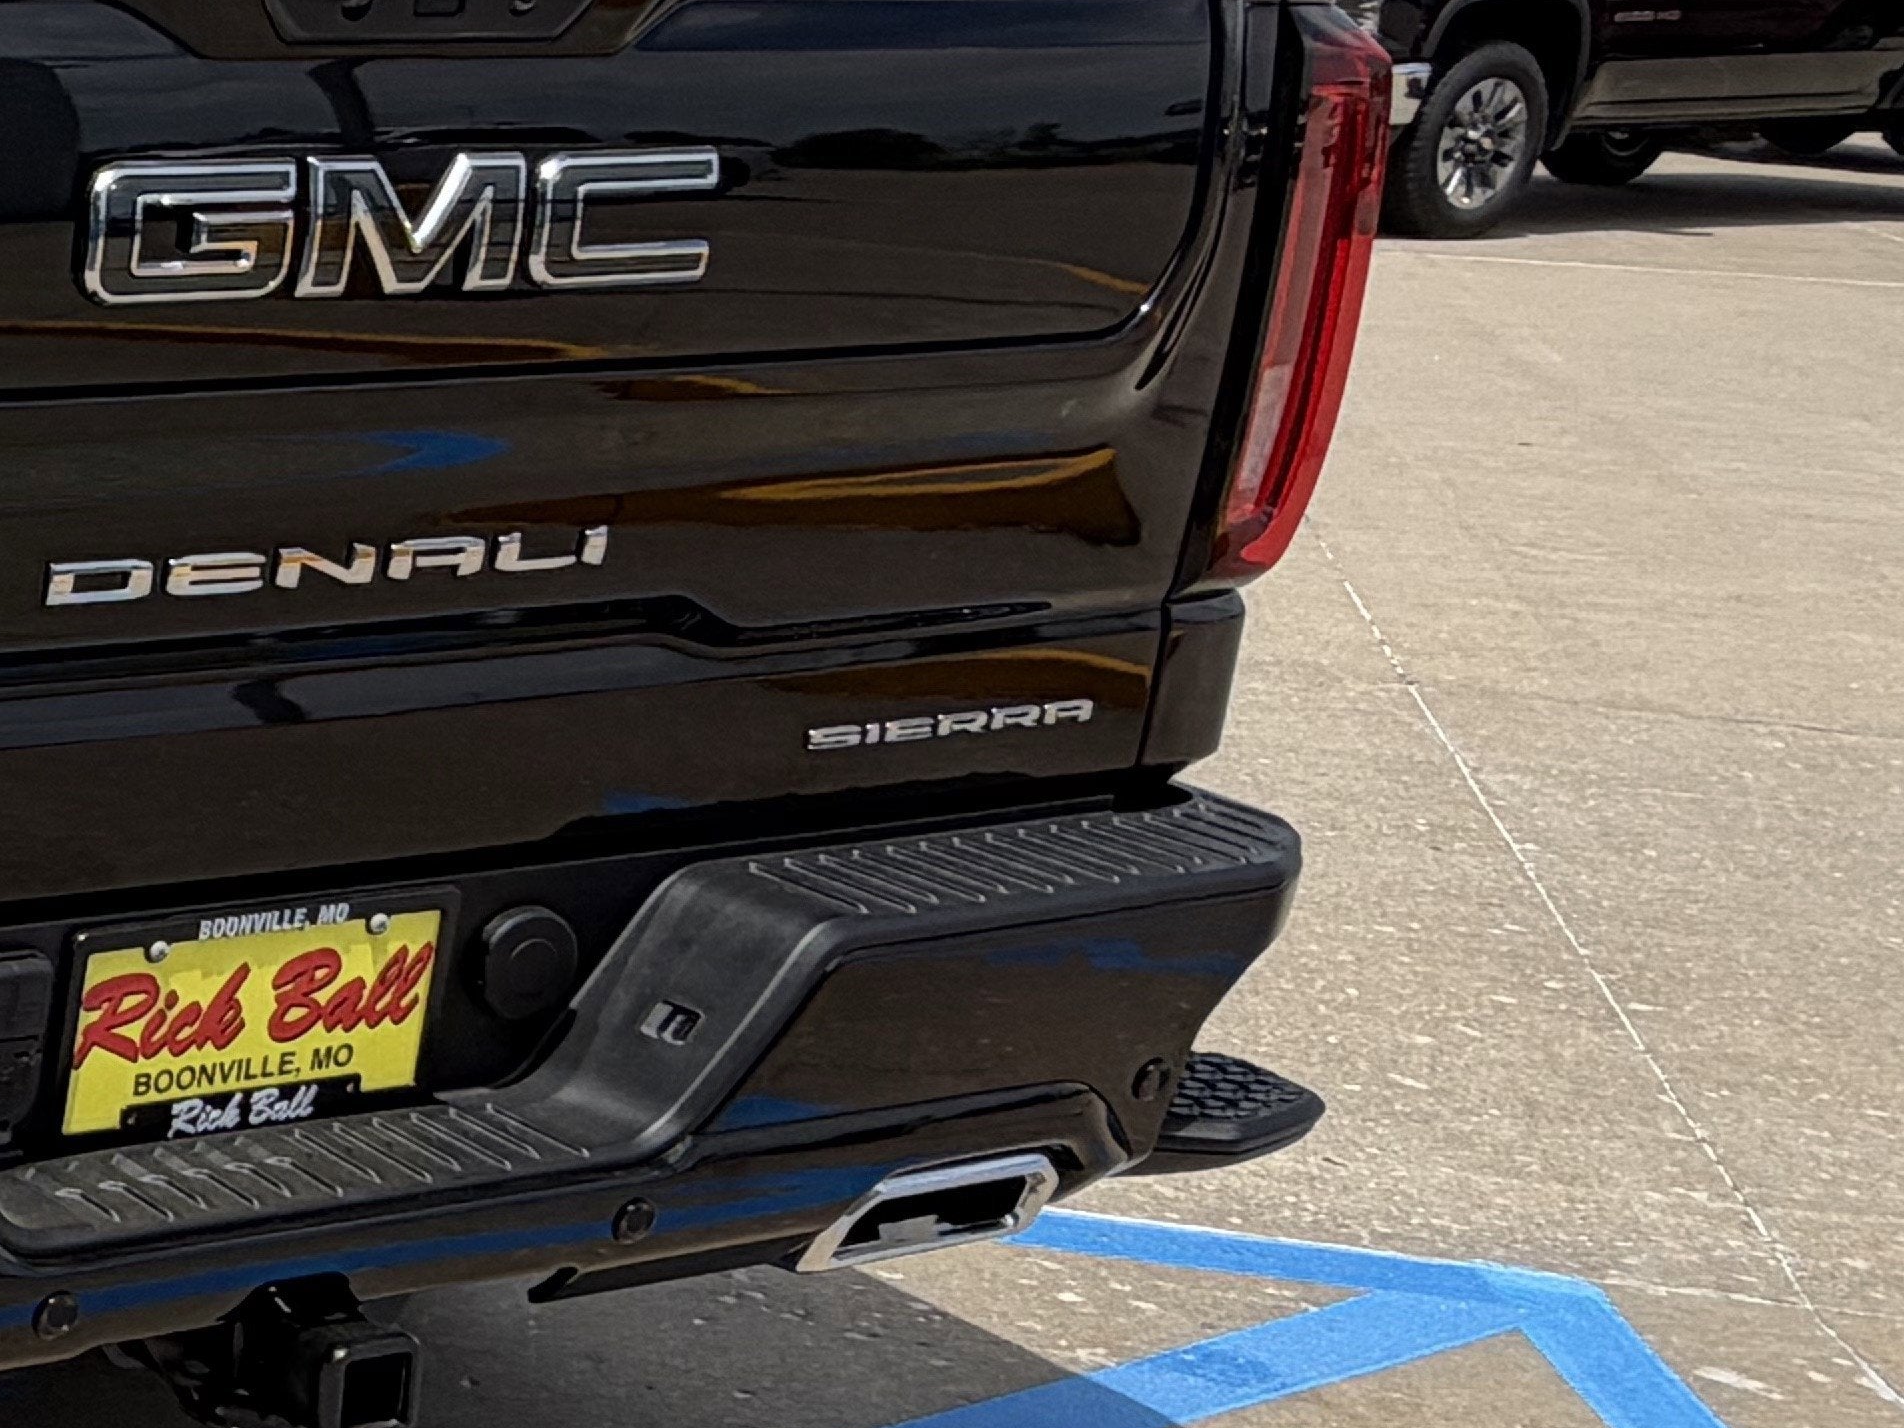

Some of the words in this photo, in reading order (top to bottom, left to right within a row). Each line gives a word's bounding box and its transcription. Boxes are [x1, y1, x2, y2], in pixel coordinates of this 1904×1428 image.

[84, 144, 720, 305] GMC
[44, 525, 608, 607] DENALI
[806, 698, 1094, 750] SIERRA
[197, 908, 311, 940] BOONVILLE,
[317, 902, 350, 924] MO
[72, 961, 252, 1071] Rick
[267, 940, 435, 1044] Ball
[132, 1050, 302, 1097] BOONVILLE,
[310, 1043, 355, 1071] MO
[167, 1091, 243, 1139] Rick
[248, 1084, 319, 1126] Ball
